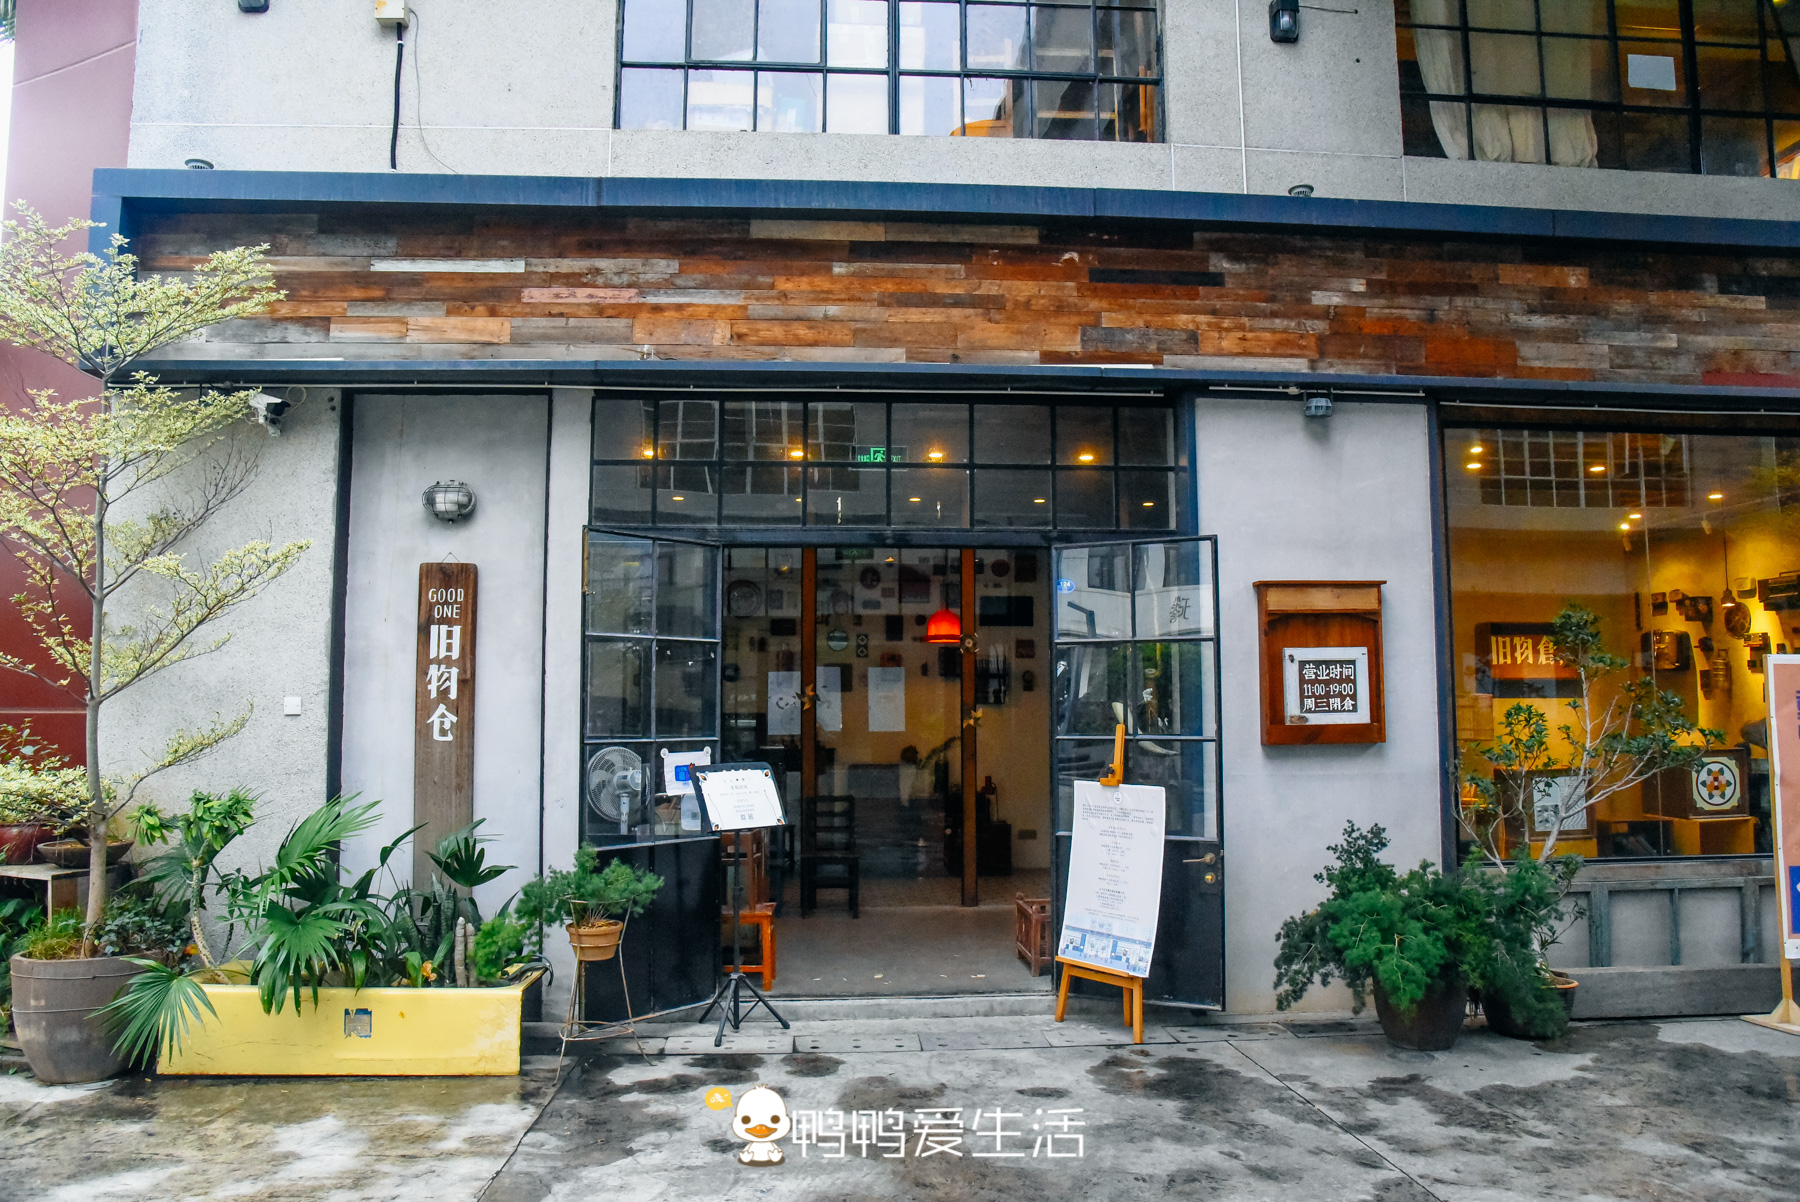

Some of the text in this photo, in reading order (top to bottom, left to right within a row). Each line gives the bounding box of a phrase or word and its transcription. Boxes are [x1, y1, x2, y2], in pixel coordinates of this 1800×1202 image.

[428, 588, 465, 603] GOOD
[434, 604, 461, 619] ONE
[1490, 635, 1566, 666] 旧物倉
[1302, 663, 1355, 680] 营业时间
[425, 624, 462, 742] 旧物仓
[1303, 683, 1354, 696] 11:00-19:00
